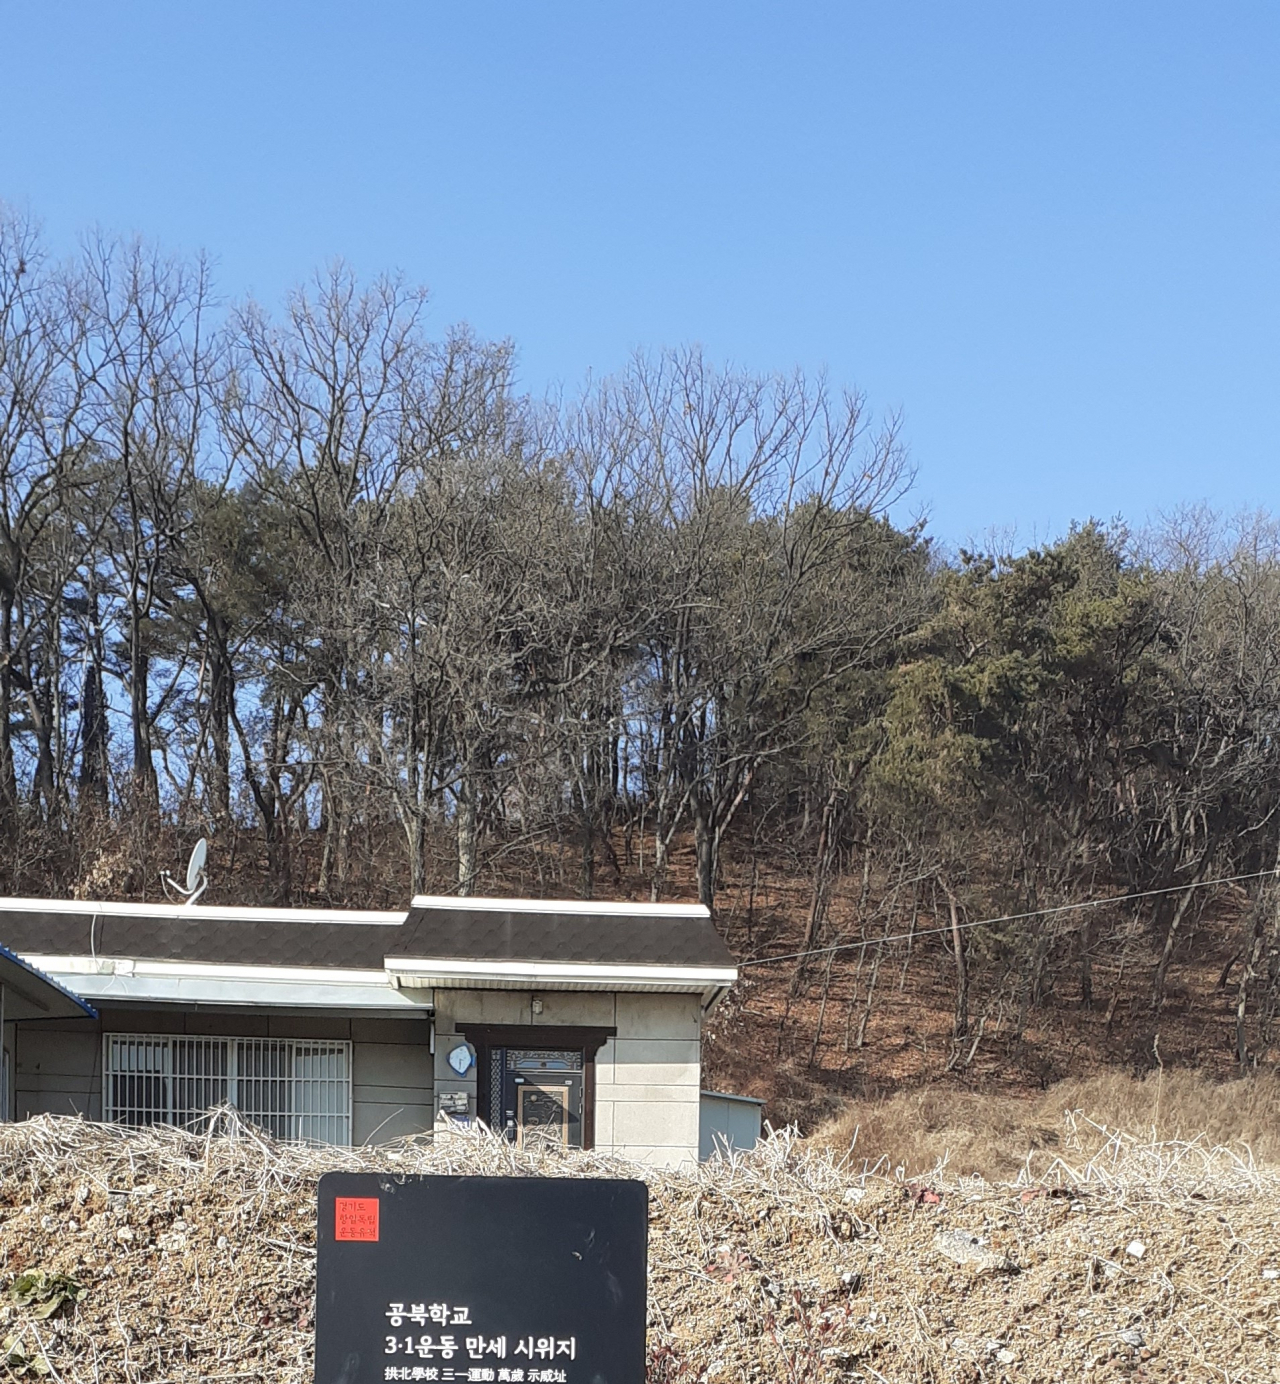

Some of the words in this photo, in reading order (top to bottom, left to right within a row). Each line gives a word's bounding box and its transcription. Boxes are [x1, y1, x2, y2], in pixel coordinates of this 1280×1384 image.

[340, 1202, 366, 1212] 경기도
[340, 1227, 375, 1237] 운동유적
[385, 1303, 472, 1326] 공북학교
[466, 1335, 506, 1359] 만세
[514, 1336, 575, 1360] 시위지
[384, 1367, 438, 1381] 拱北學校
[498, 1368, 524, 1382] 萬歲
[527, 1369, 566, 1382] 示威址
